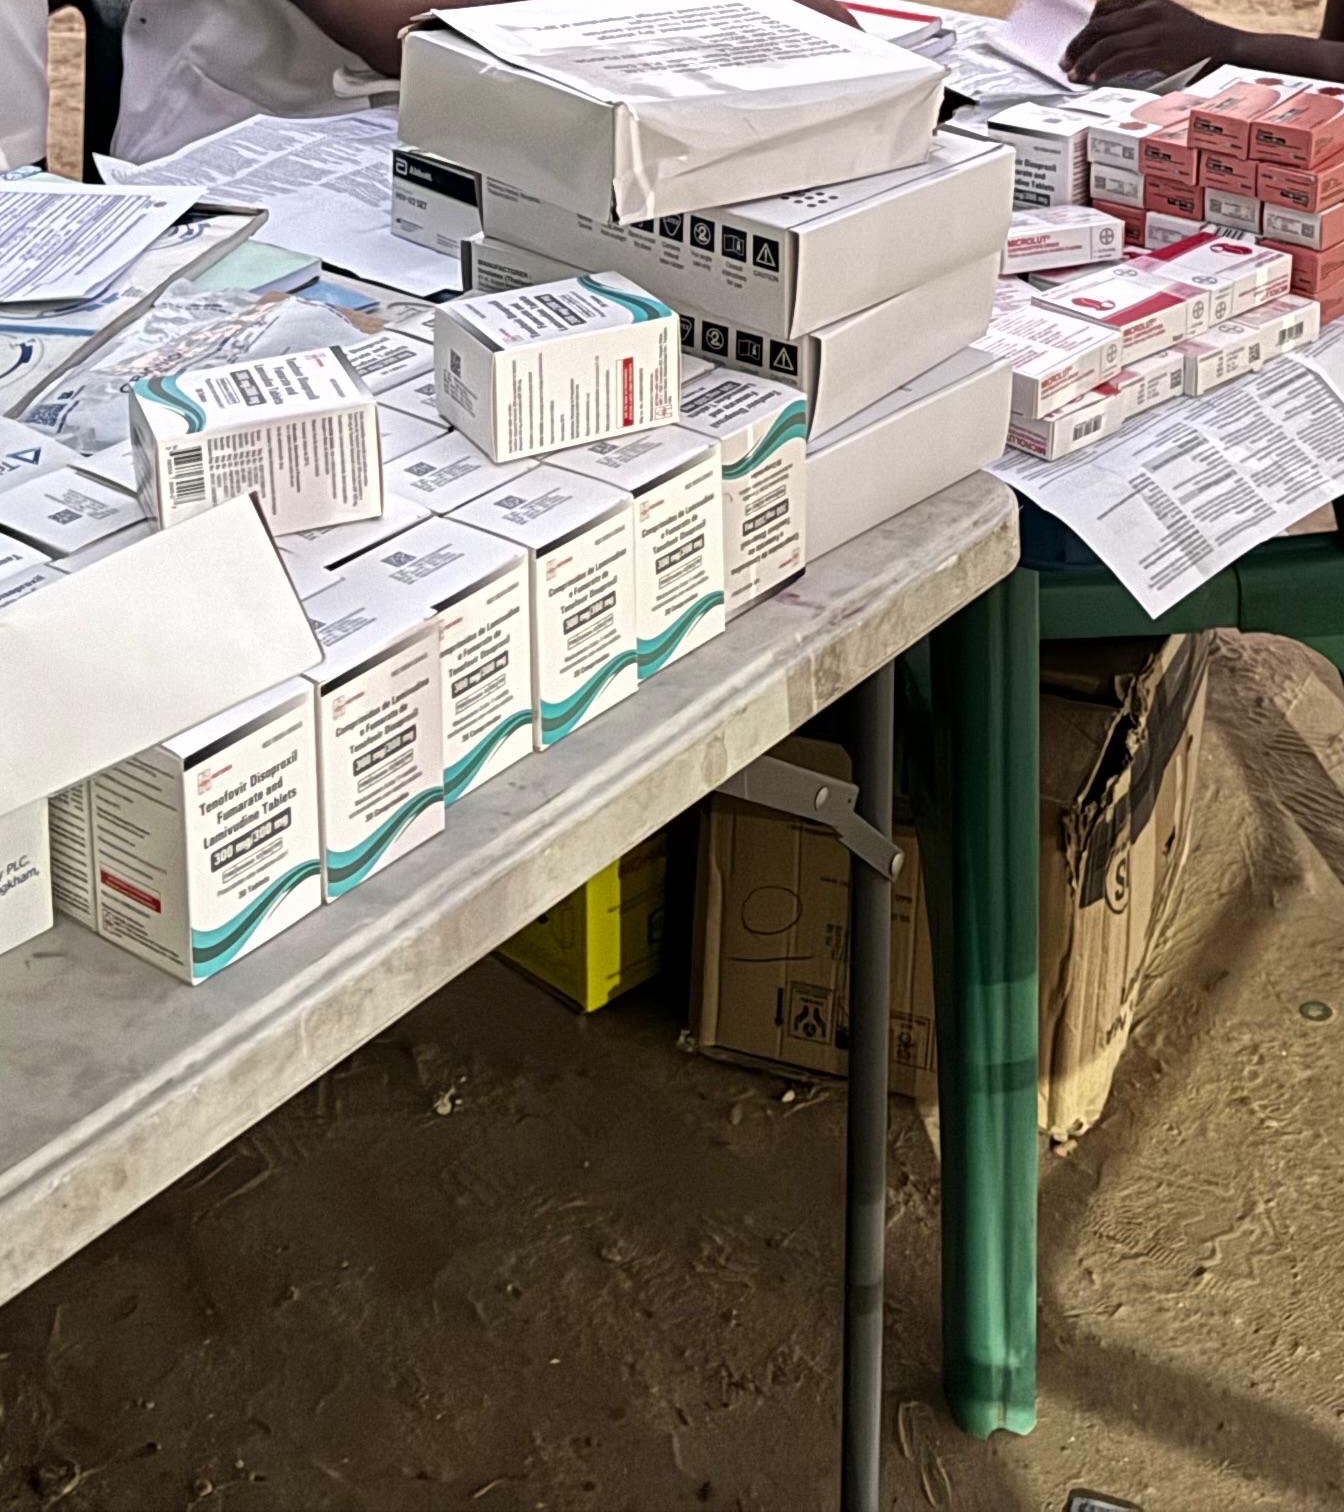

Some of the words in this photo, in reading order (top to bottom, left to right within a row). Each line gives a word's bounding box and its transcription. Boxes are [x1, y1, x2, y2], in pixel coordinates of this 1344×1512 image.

[478, 259, 529, 279] MANUFACTURER
[1007, 434, 1047, 456] MICROLU
[198, 781, 248, 817] Tenofovir
[250, 749, 298, 788] Disoproxil
[217, 790, 264, 825] Fumarate
[266, 775, 284, 795] and
[203, 810, 260, 850] Lamivudine
[262, 787, 298, 815] Tablets
[6, 855, 30, 877] PLC.
[213, 845, 233, 867] 300
